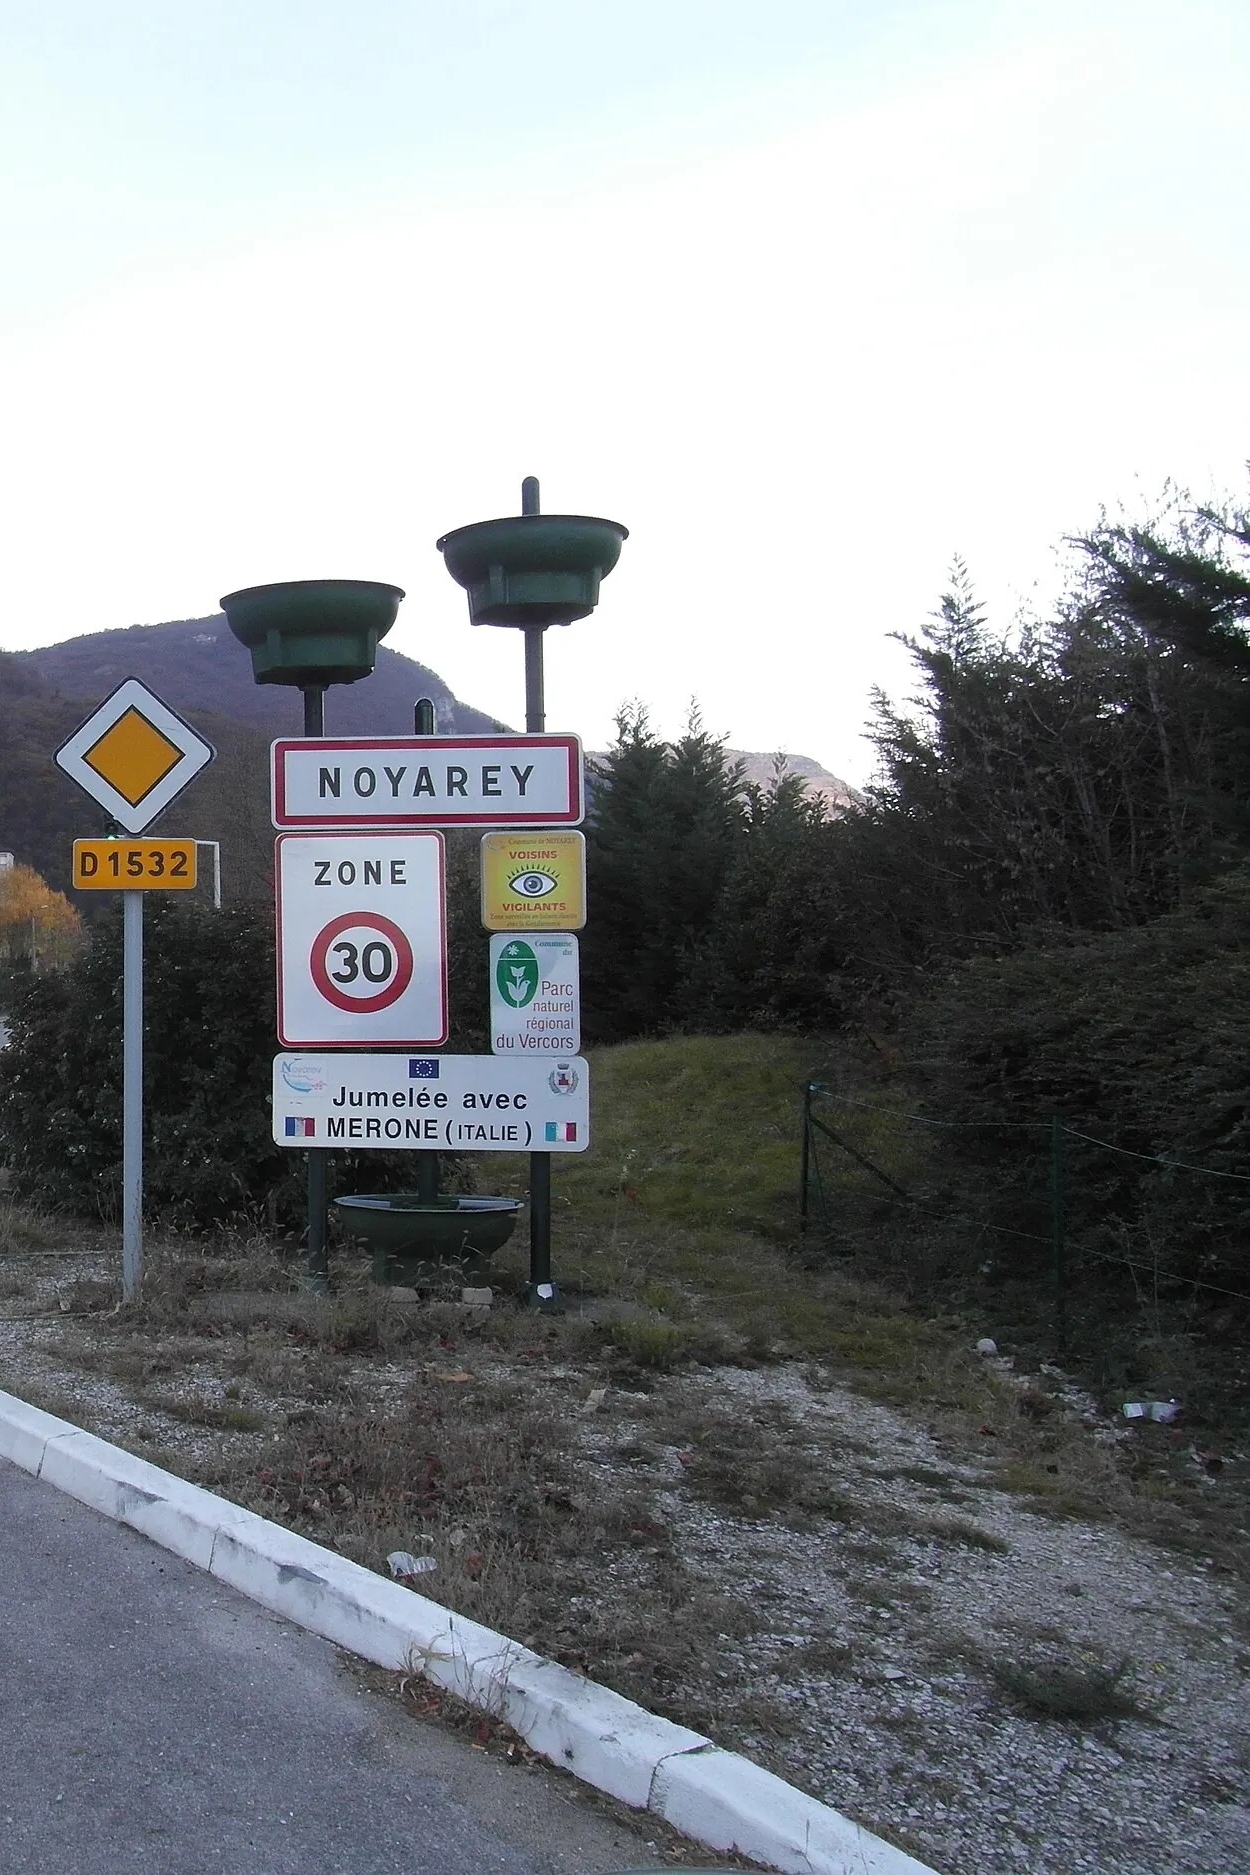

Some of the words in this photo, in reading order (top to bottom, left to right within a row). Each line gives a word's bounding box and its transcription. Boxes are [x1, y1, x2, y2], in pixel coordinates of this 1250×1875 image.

[319, 765, 534, 798] NOYAREY
[509, 850, 558, 860] VOISINS
[80, 851, 99, 877] D
[108, 851, 188, 877] 1532
[314, 859, 407, 886] ZONE
[502, 902, 566, 911] VIGILANTS
[534, 940, 572, 948] Commune
[562, 948, 573, 956] du
[331, 941, 392, 984] 30
[541, 981, 573, 996] Parc
[533, 1000, 574, 1012] naturel
[526, 1017, 574, 1032] régional
[496, 1033, 514, 1049] du
[519, 1033, 574, 1049] Vercors
[332, 1086, 448, 1109] Jumelée
[462, 1092, 527, 1109] avec
[327, 1117, 439, 1139] MERONE
